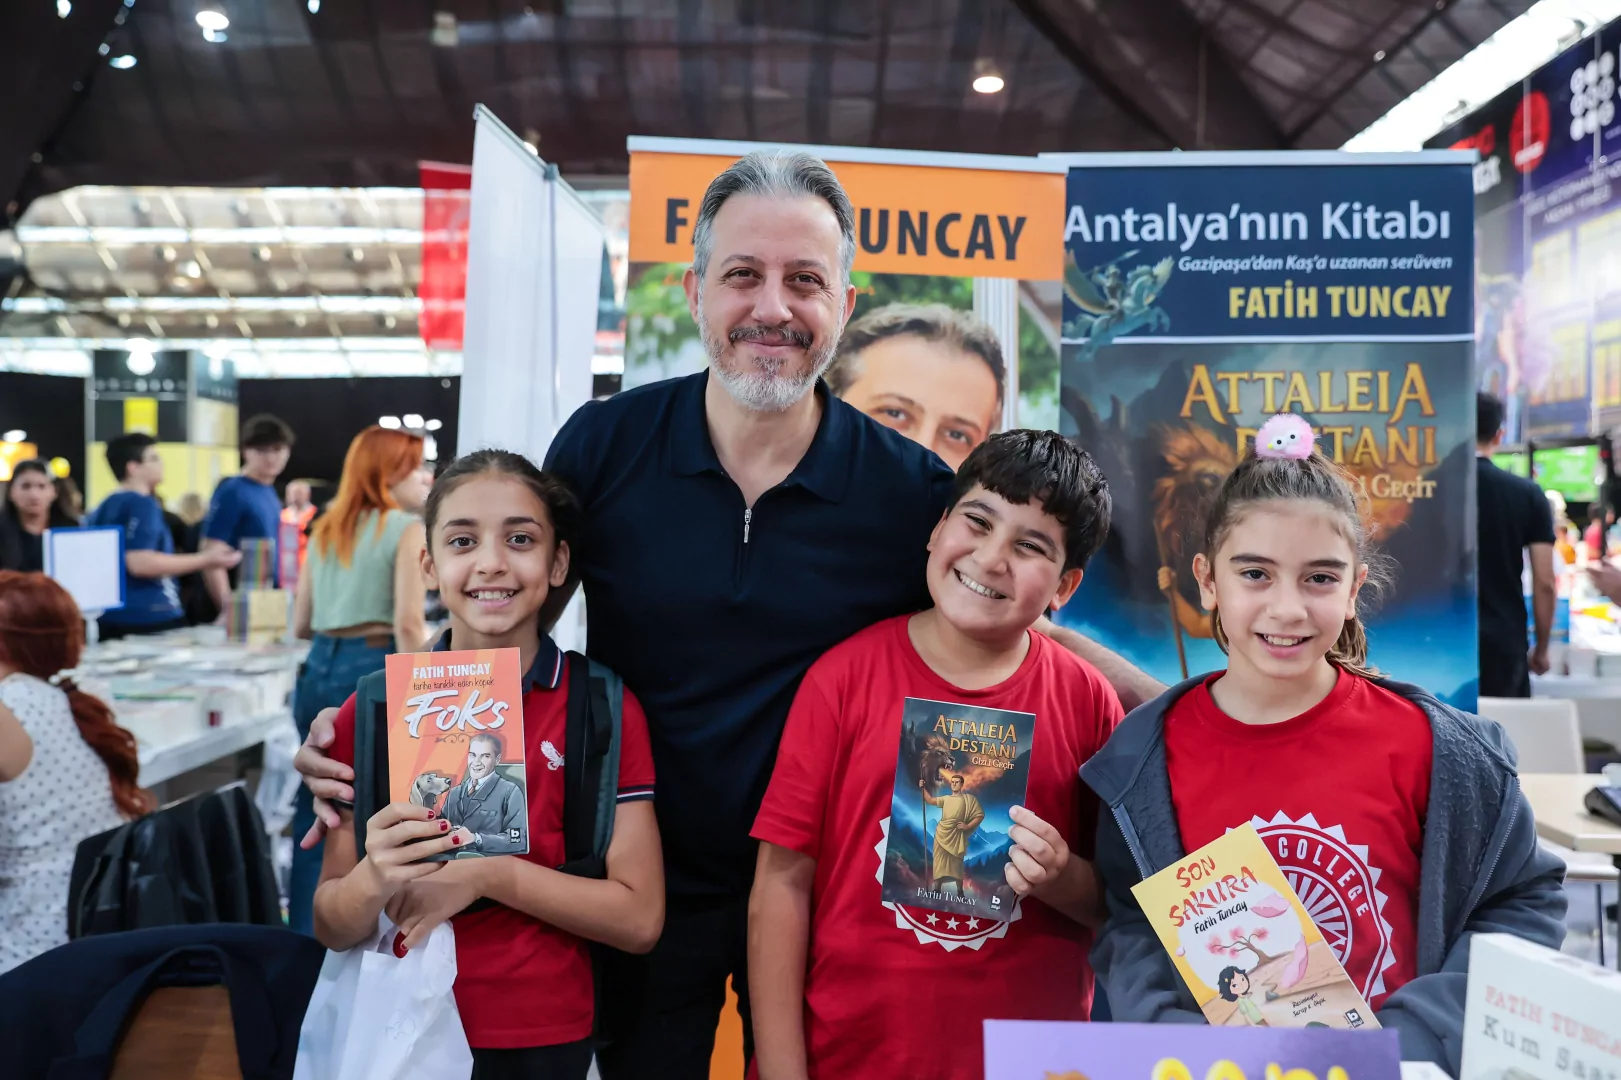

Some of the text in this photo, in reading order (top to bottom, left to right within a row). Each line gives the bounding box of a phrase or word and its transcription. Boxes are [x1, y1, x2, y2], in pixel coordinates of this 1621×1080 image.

[858, 207, 1027, 261] UNCAY
[1064, 200, 1451, 251] Antalya'nın Kitabı
[1178, 254, 1453, 274] Gazipaşa'dan Kaş'a uzanan serüven
[1229, 279, 1453, 318] FATİH TUNCAY
[1179, 362, 1437, 424] ATTALEIA
[1235, 425, 1437, 468] DTANI
[413, 662, 490, 680] FATİH TUNCAY
[932, 714, 1018, 744] ATTALEIA
[949, 737, 1017, 759] DESTANI
[1176, 854, 1216, 889] SON
[1278, 836, 1369, 917] COLLEGE
[1168, 866, 1259, 928] SAKURA
[1193, 900, 1248, 935] Fatih Tuncay
[1482, 1014, 1541, 1060] Kum
